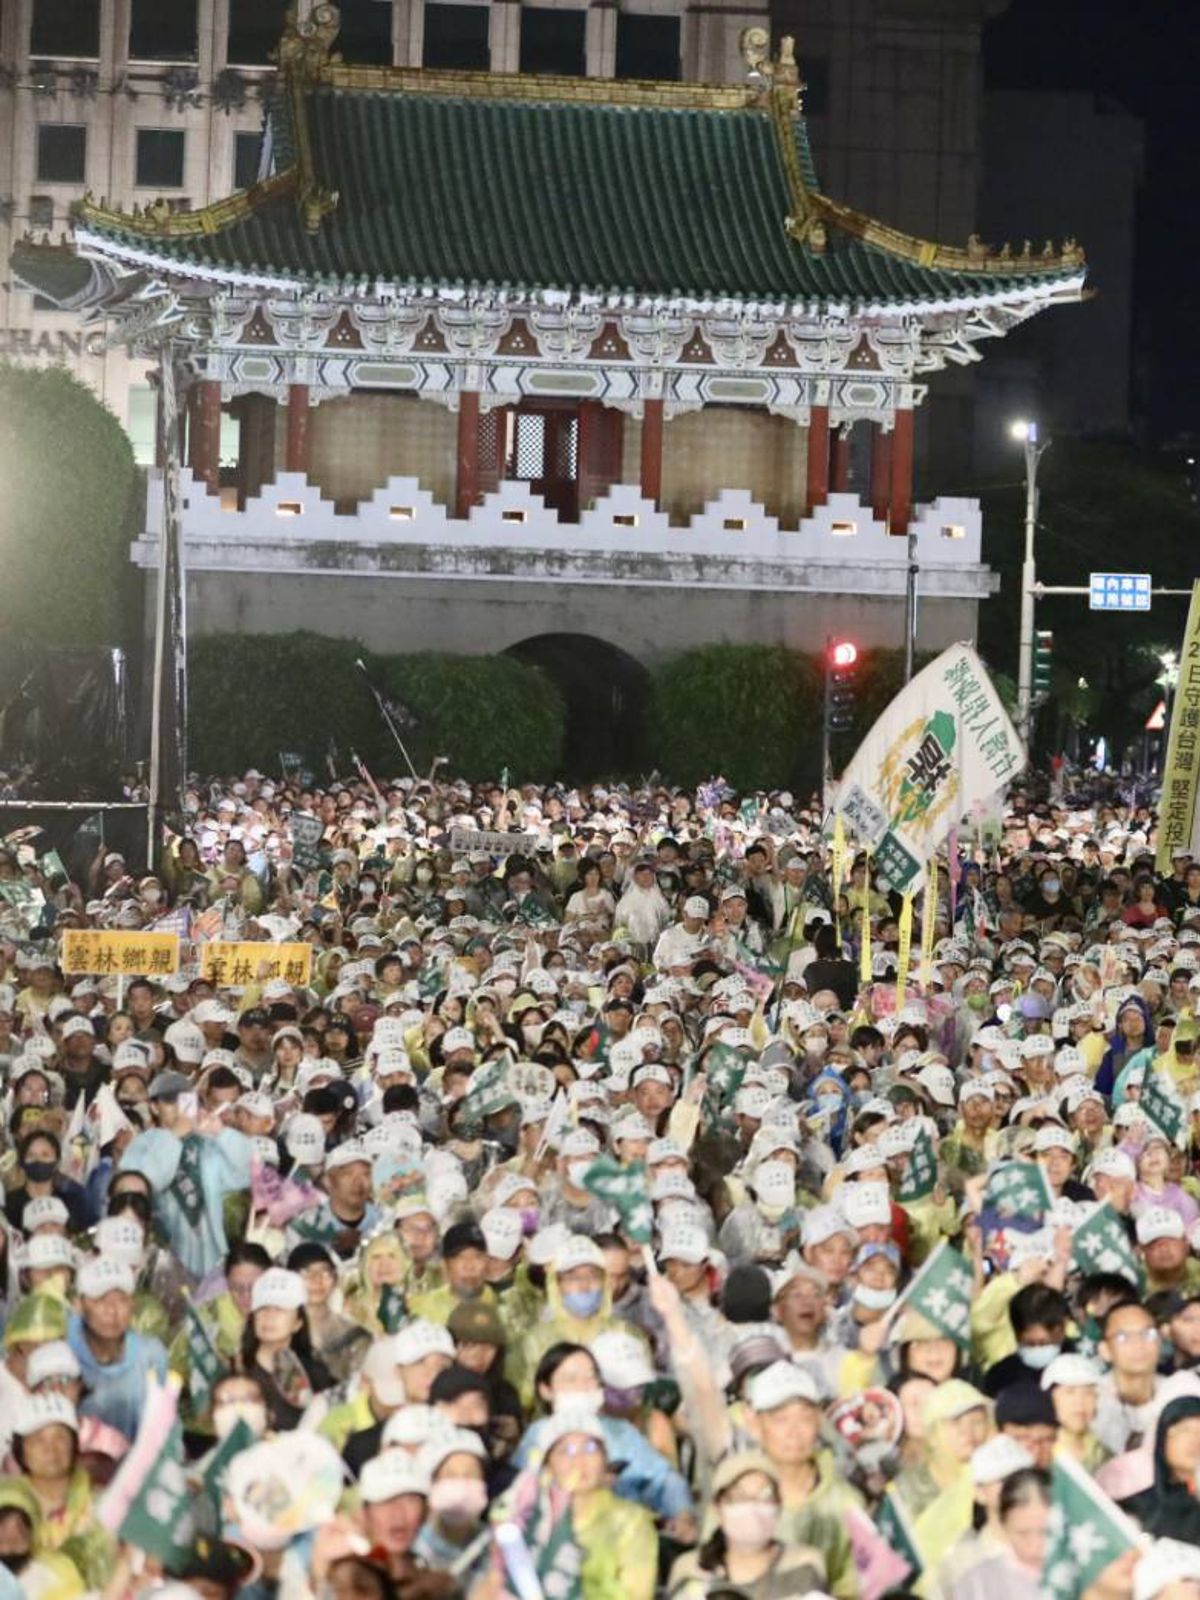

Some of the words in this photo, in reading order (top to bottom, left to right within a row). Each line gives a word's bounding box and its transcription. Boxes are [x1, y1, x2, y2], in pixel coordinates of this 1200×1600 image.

[0, 328, 107, 357] HANG
[68, 945, 175, 974] 雲林鄉親
